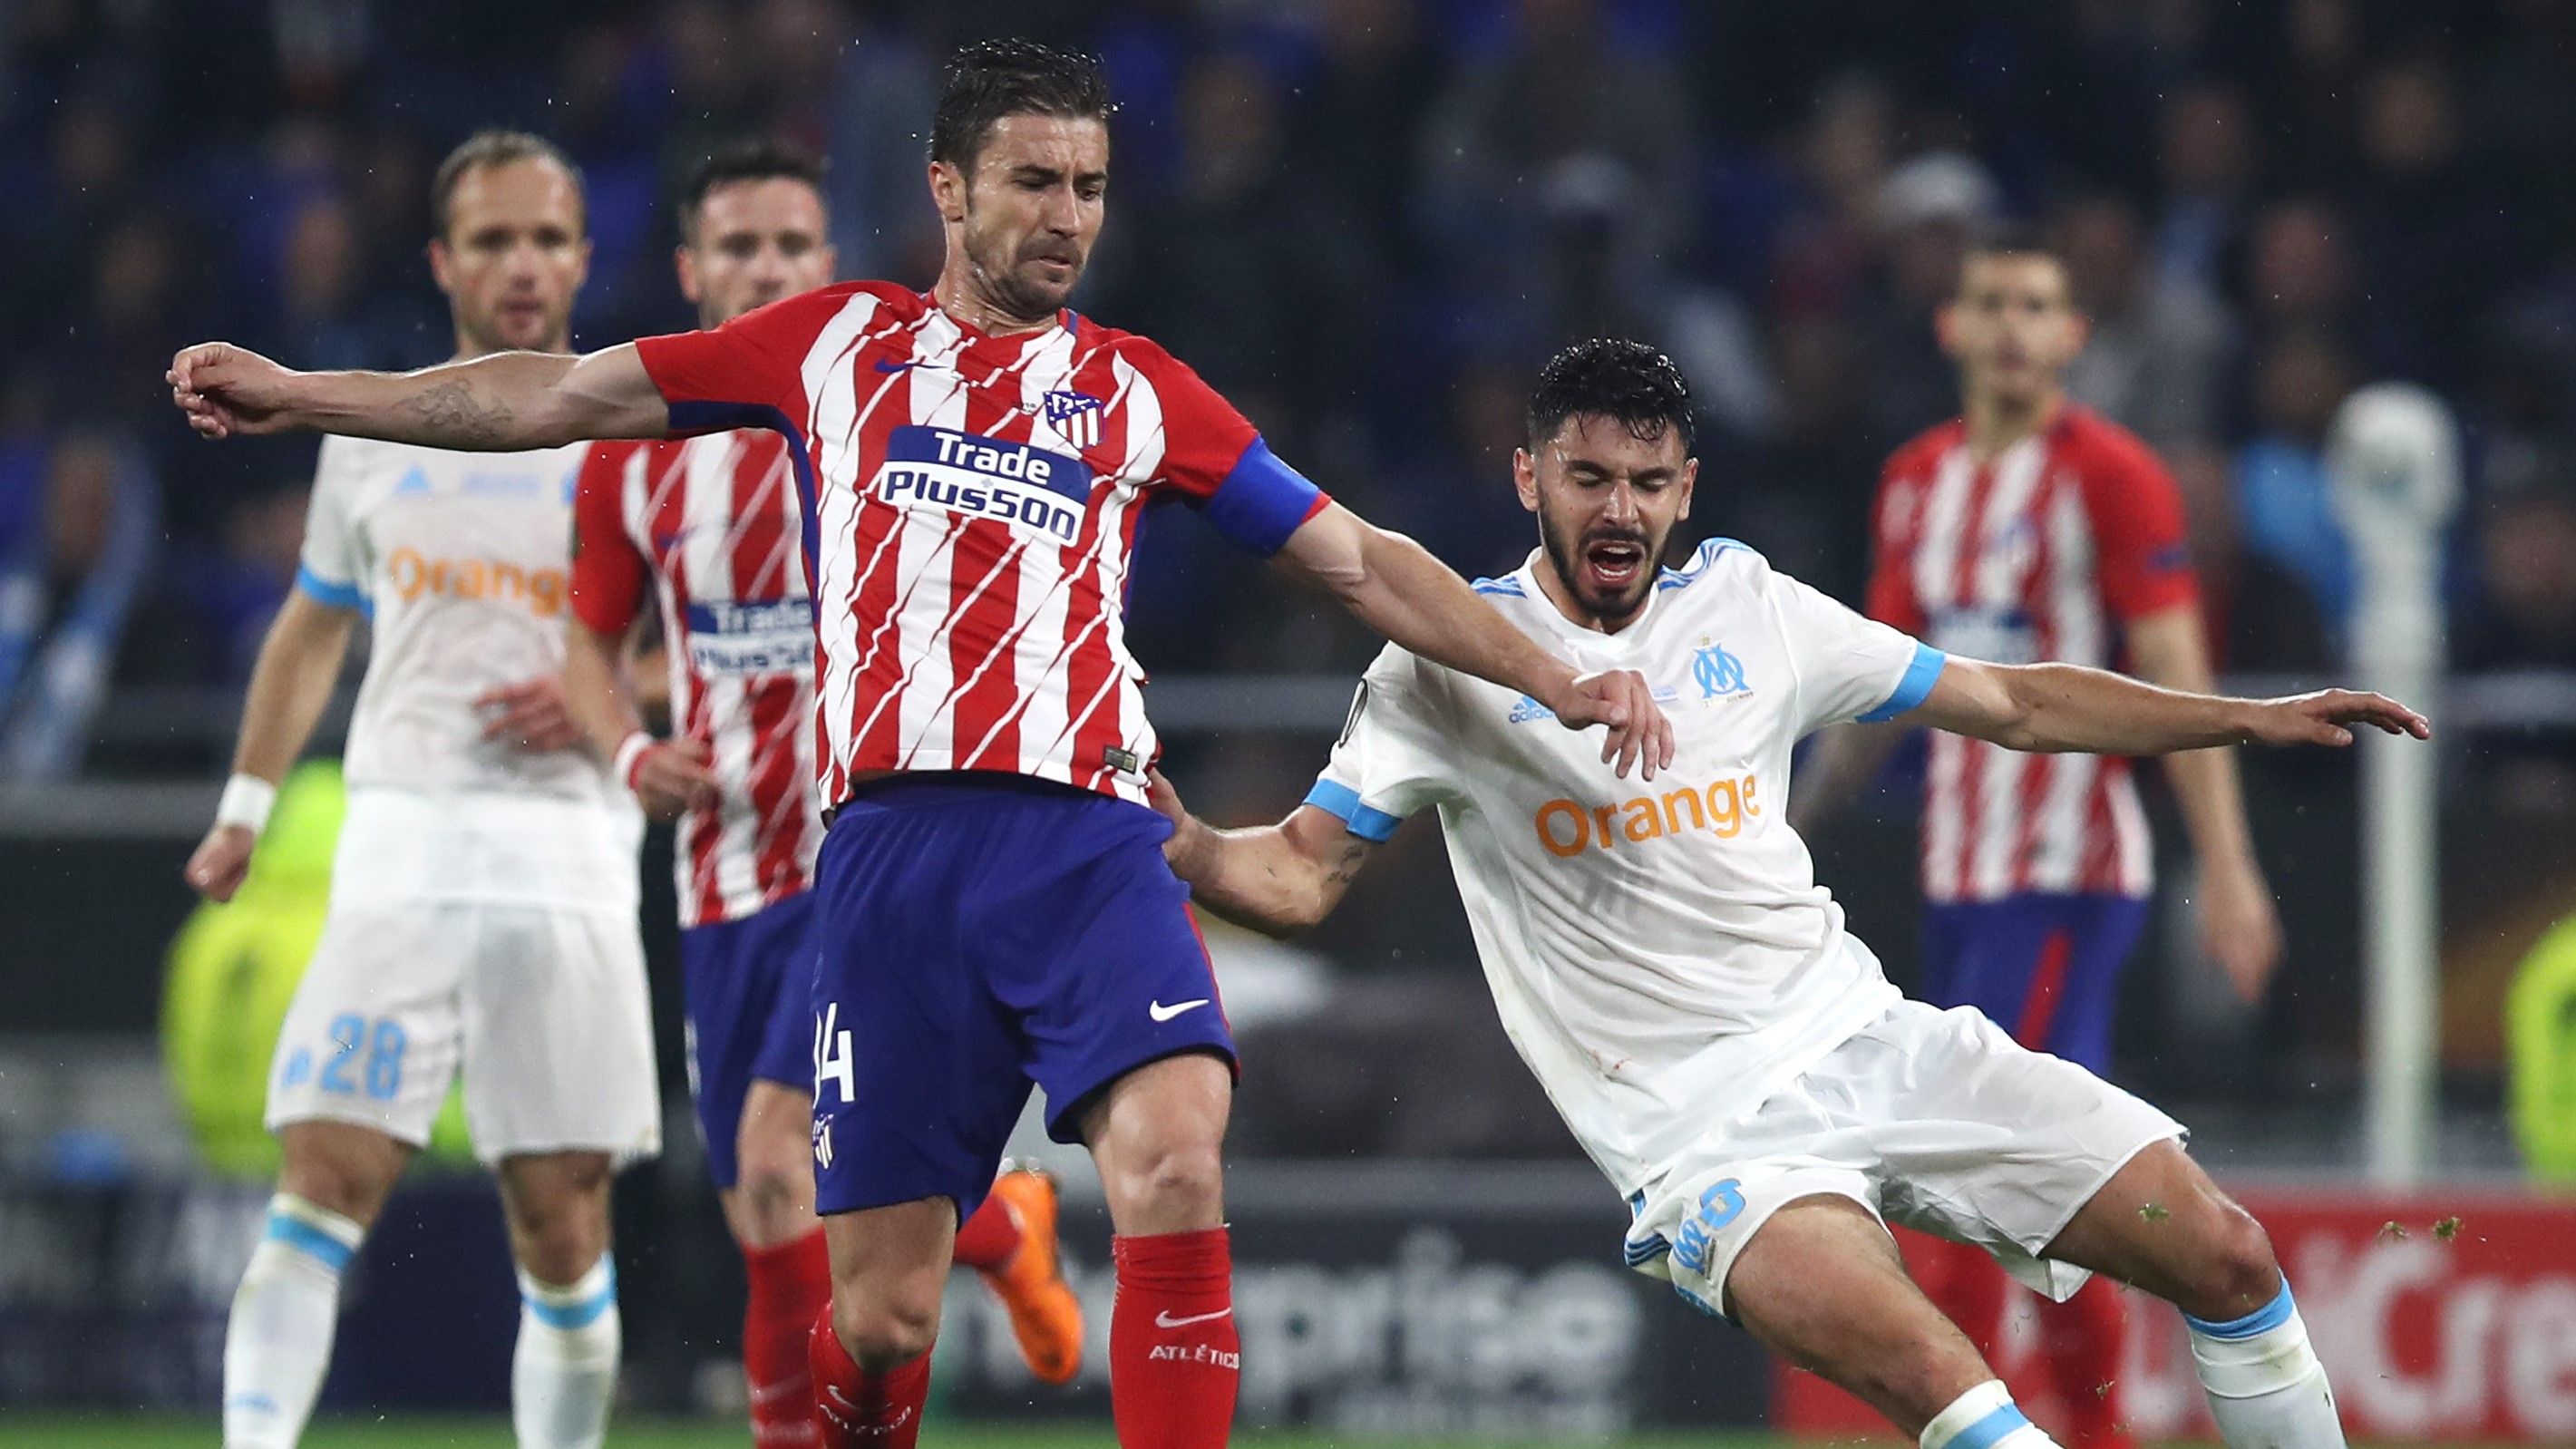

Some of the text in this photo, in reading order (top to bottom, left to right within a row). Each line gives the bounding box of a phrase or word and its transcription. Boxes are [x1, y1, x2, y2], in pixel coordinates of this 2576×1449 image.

[935, 432, 1052, 485] Trade
[884, 471, 1076, 541] Plus500
[389, 545, 566, 618] Orang
[1535, 773, 1761, 858] Orange
[319, 1013, 408, 1101] 28
